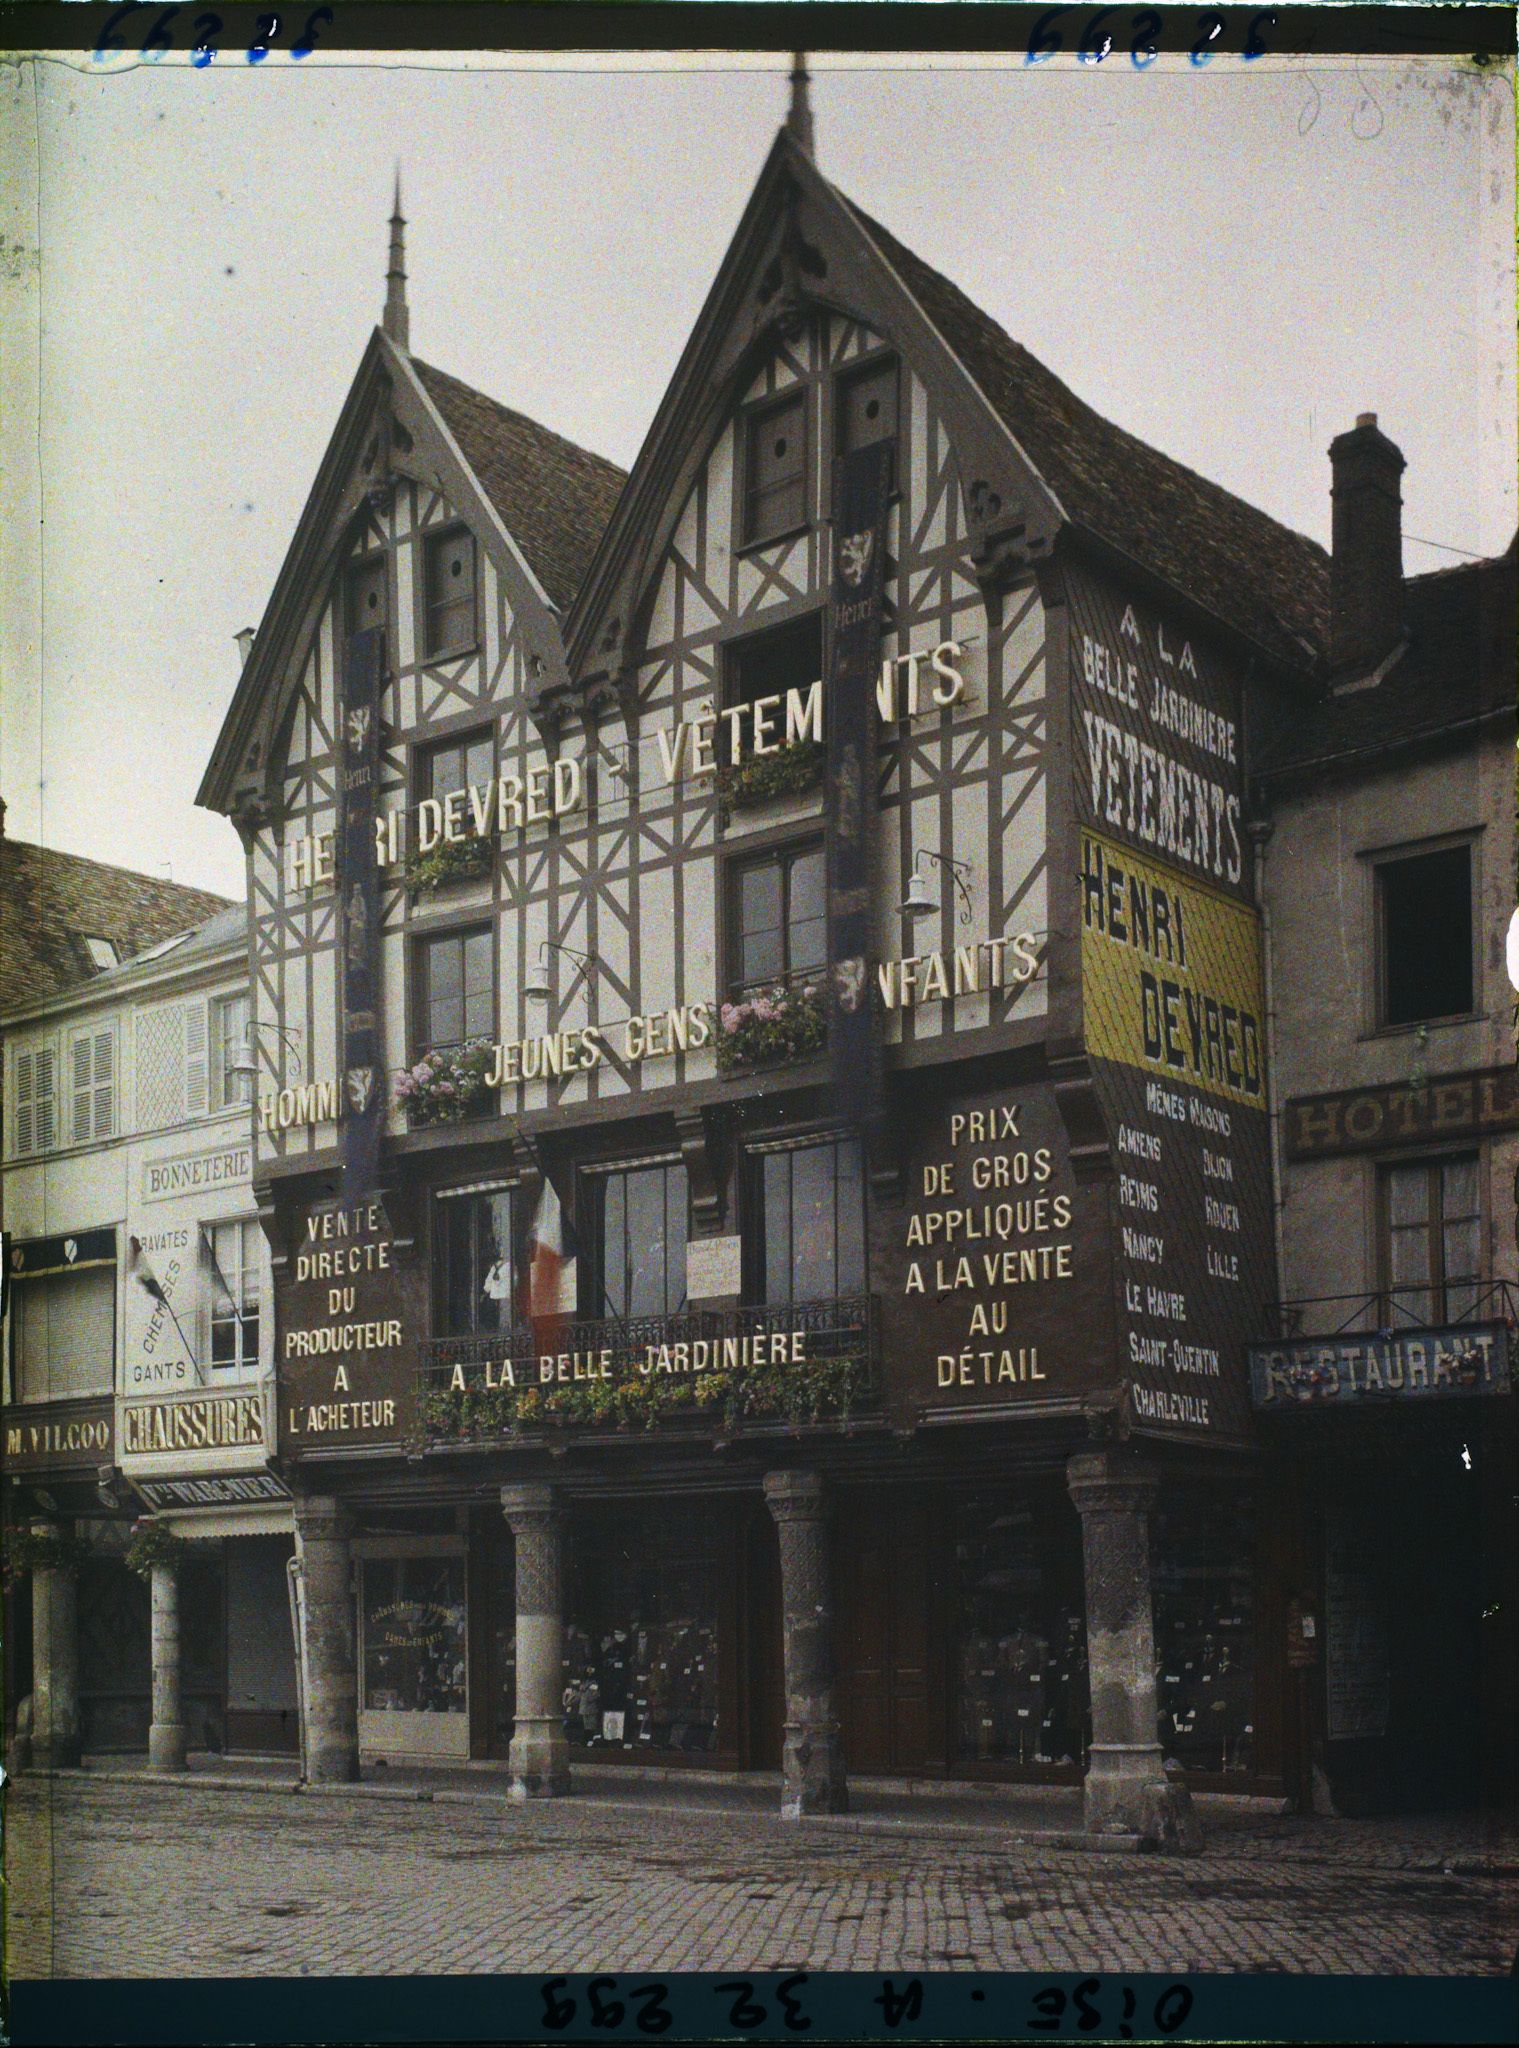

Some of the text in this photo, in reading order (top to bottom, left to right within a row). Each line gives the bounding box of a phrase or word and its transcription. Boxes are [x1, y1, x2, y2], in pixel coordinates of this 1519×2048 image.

[1120, 604, 1198, 679] A LA
[1083, 634, 1237, 765] BELLE JARDINIERE
[289, 810, 398, 892] HERI
[419, 758, 580, 852] DEVRED
[657, 640, 964, 784] VÊTEMNTS
[1083, 710, 1241, 884] VETEMENTS
[1084, 839, 1188, 970] HENRI
[260, 932, 1039, 1132] HOMM JEUNES GENS NFANTS
[1140, 970, 1262, 1097] DEVRED
[951, 1105, 1020, 1146] PRIX
[1296, 1077, 1519, 1148] HOTEL
[1118, 1123, 1162, 1162] AMIENS
[150, 1150, 249, 1193] BONNETERIE
[924, 1148, 1052, 1197] DE GROS
[1119, 1174, 1158, 1213] REIMS
[1205, 1196, 1240, 1232] ROUEN
[307, 1205, 379, 1242] VENTE
[906, 1188, 1073, 1247] APPLIQUÉS
[140, 1229, 189, 1253] RAVATES
[297, 1242, 390, 1283] DIRECTE
[1122, 1227, 1164, 1265] NANCY
[905, 1245, 1074, 1294] A LA VENTE
[1207, 1245, 1239, 1281] LILLE
[143, 1259, 181, 1354] CHEMSES
[328, 1287, 355, 1316] DU
[969, 1301, 1008, 1337] AU
[1125, 1278, 1187, 1322] LE HAVRE
[285, 1320, 402, 1359] PRODUCTEUR
[450, 1325, 807, 1391] A LA BELLE JARDINIÈRE
[133, 1361, 186, 1383] GANTS
[333, 1364, 349, 1392] A
[937, 1345, 1047, 1387] DÉTAIL
[124, 1396, 264, 1451] CHAUSSURES
[290, 1400, 395, 1433] L'ACHETEUR
[1133, 1383, 1209, 1425] CHARLEVILLE
[541, 1977, 673, 2034] 299
[713, 1976, 812, 2031] 32
